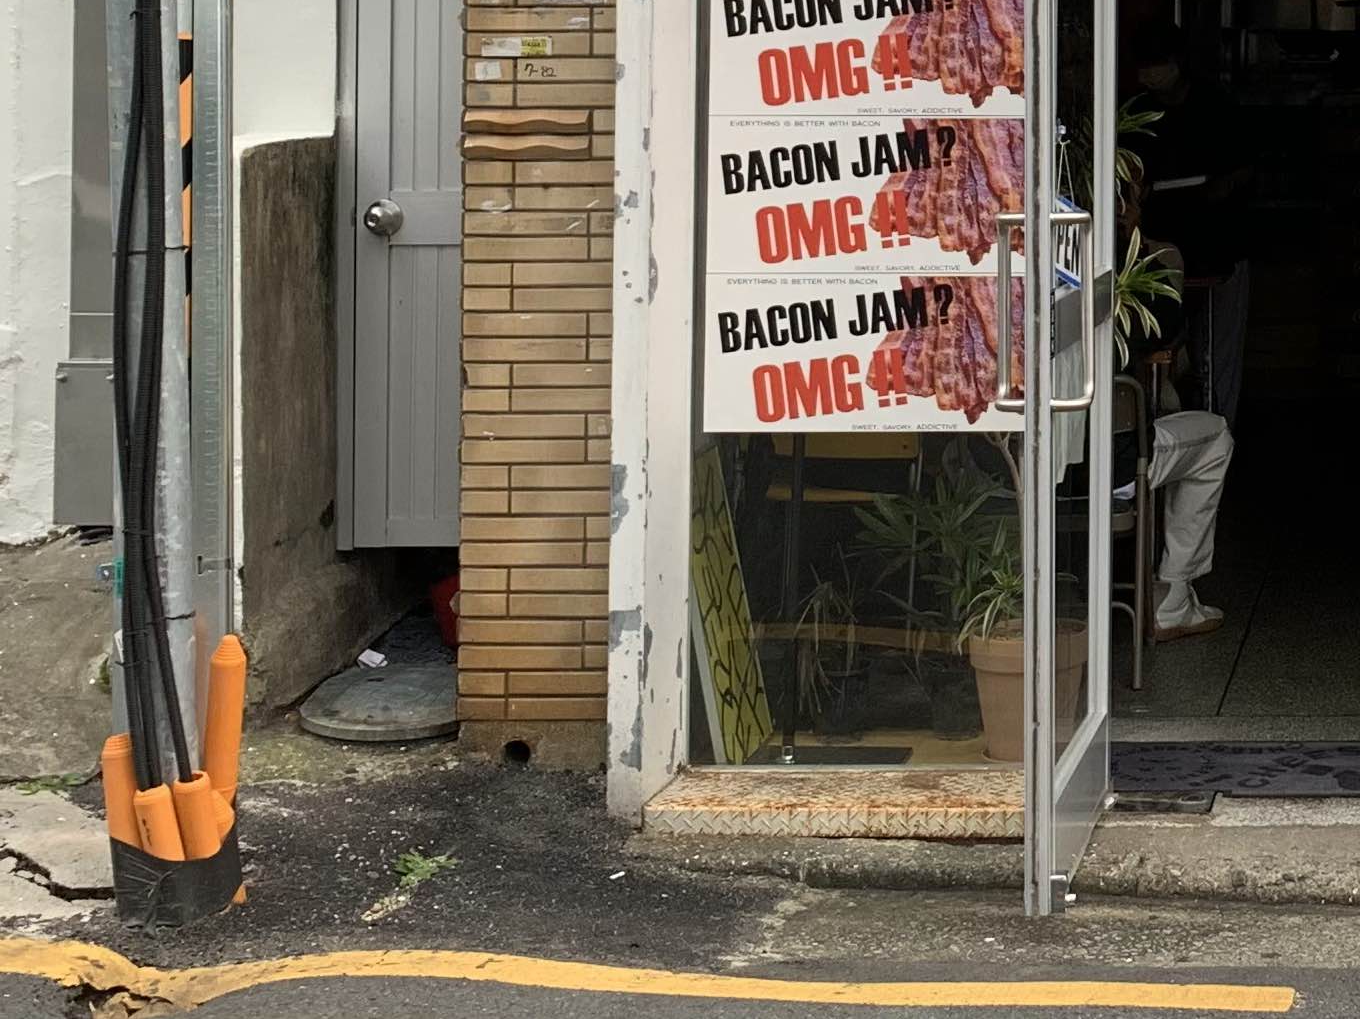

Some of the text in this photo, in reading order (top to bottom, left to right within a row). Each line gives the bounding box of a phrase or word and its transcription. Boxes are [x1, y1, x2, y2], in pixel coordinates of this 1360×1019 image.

[720, 126, 956, 195] BACON JAM?
[718, 284, 954, 353] BACON JAM?
